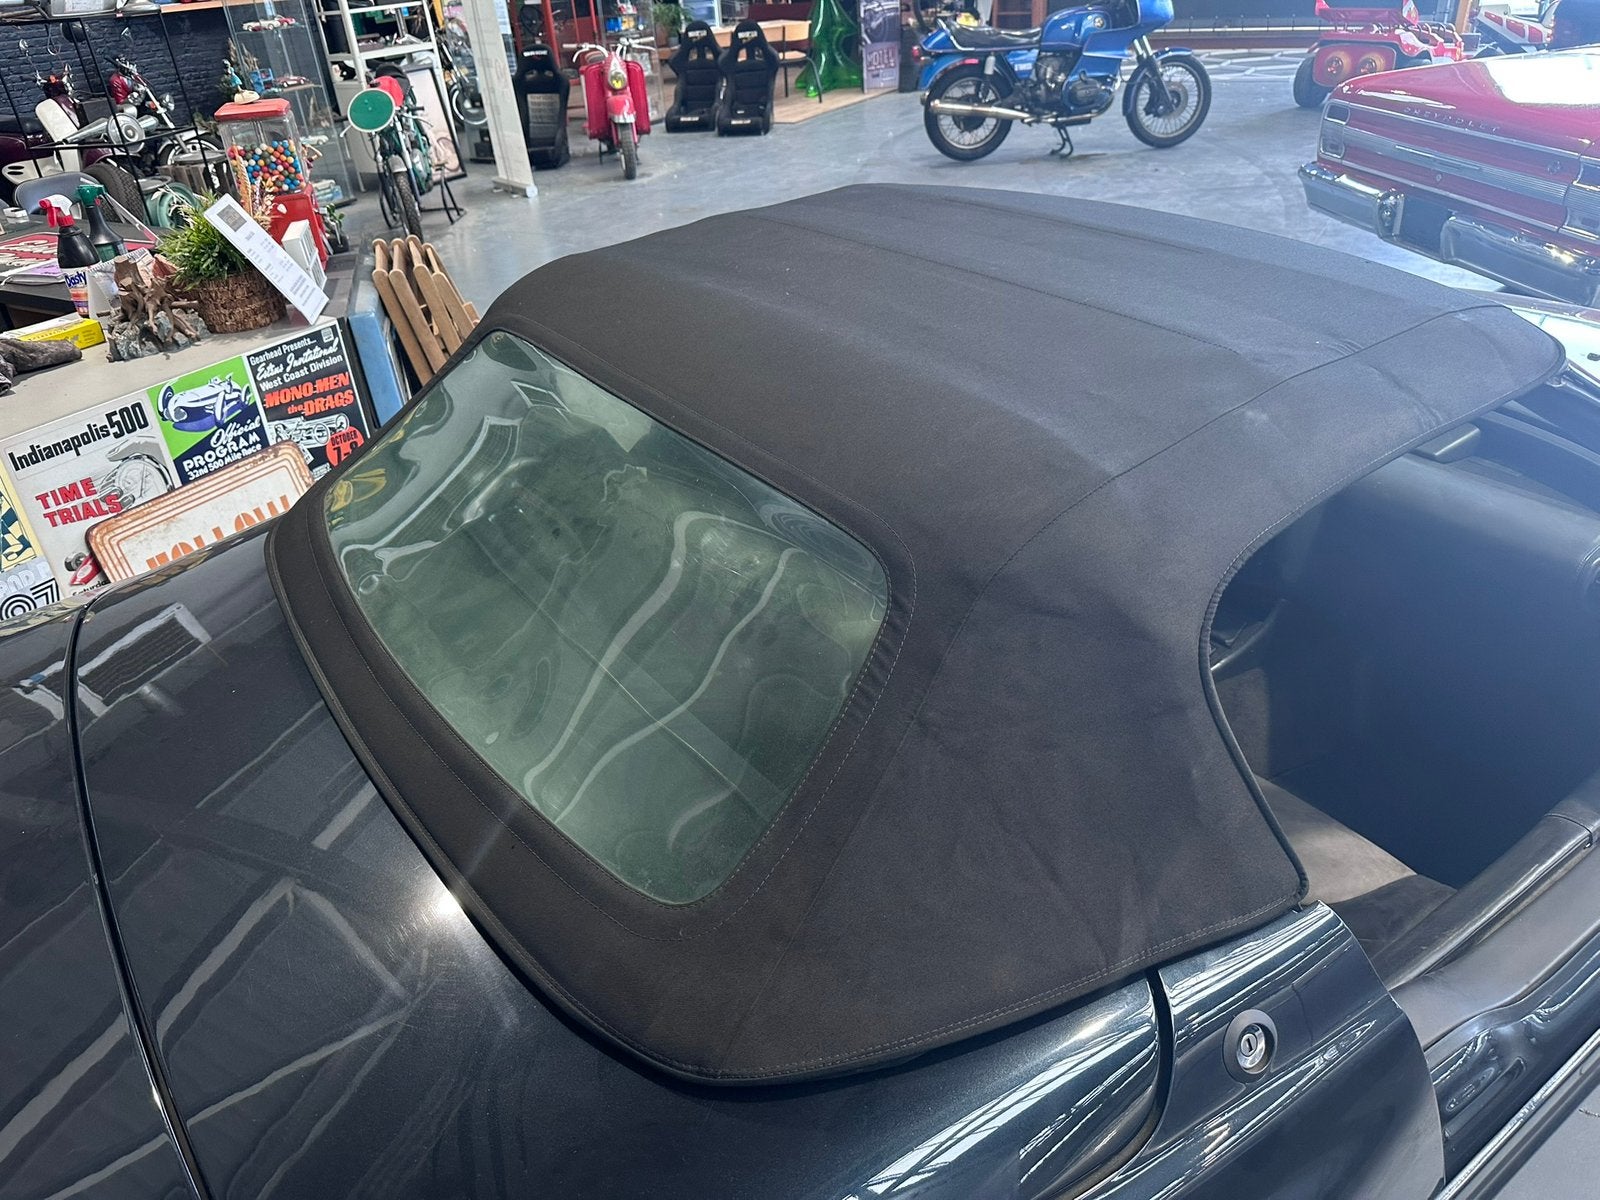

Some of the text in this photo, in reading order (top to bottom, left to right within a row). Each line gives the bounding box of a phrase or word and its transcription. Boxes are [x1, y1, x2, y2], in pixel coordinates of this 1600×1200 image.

[64, 271, 87, 288] Dasty
[249, 348, 283, 366] Gearhead
[259, 354, 343, 392] West Coast Division
[287, 389, 354, 416] the DRAGS
[8, 401, 149, 472] Indianapolis 500
[210, 415, 261, 448] Official
[330, 429, 359, 447] OCTOBER
[182, 431, 261, 473] PROGRAM
[187, 442, 262, 481] 32nd 500 Mile Race
[35, 477, 97, 509] TIME
[43, 494, 123, 527] TRIALS
